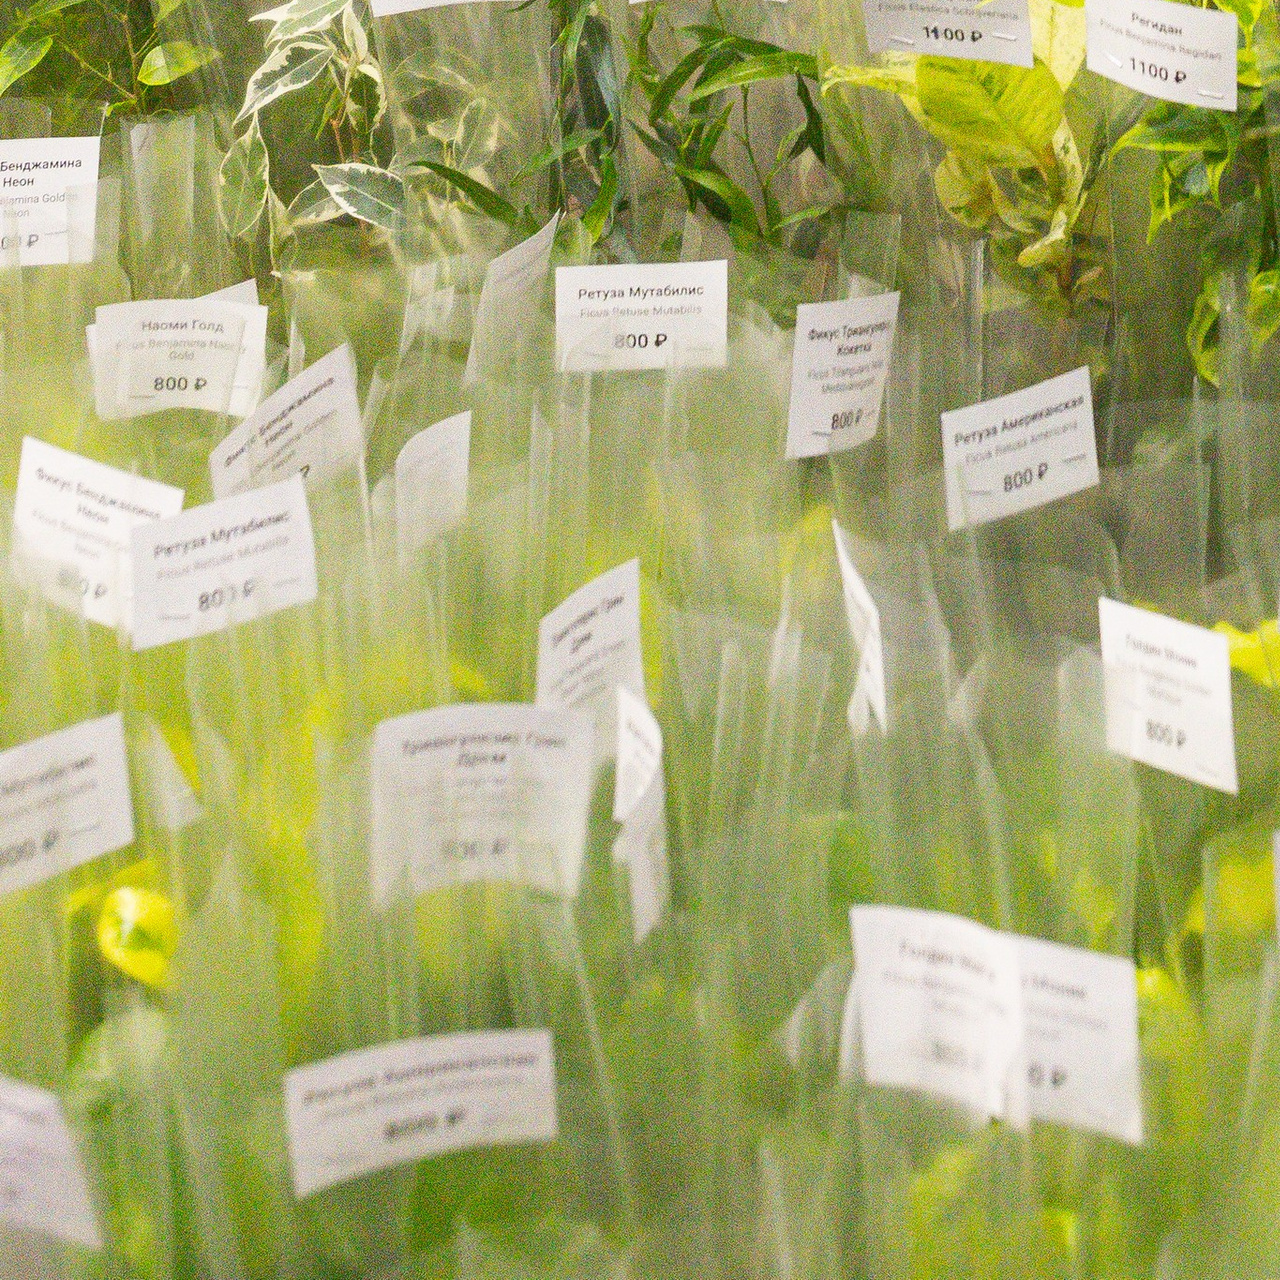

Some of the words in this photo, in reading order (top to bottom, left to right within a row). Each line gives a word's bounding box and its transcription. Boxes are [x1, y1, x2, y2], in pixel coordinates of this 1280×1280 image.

[1130, 11, 1183, 38] Регидан
[1128, 56, 1170, 84] 1100
[0, 157, 83, 174] Бенджамина
[2, 175, 35, 189] Неон
[578, 286, 626, 302] Ретуза
[628, 283, 704, 301] Мутабилис
[141, 320, 189, 334] Наоми
[191, 319, 224, 334] Голд
[613, 333, 649, 350] 800
[153, 376, 189, 392] 800
[194, 377, 208, 391] ₽
[830, 410, 857, 430] 800
[953, 424, 999, 449] Ретуза
[999, 394, 1085, 433] Американская
[1002, 467, 1034, 494] 800
[154, 534, 208, 561] Ретуза
[209, 508, 292, 547] Мутабилис
